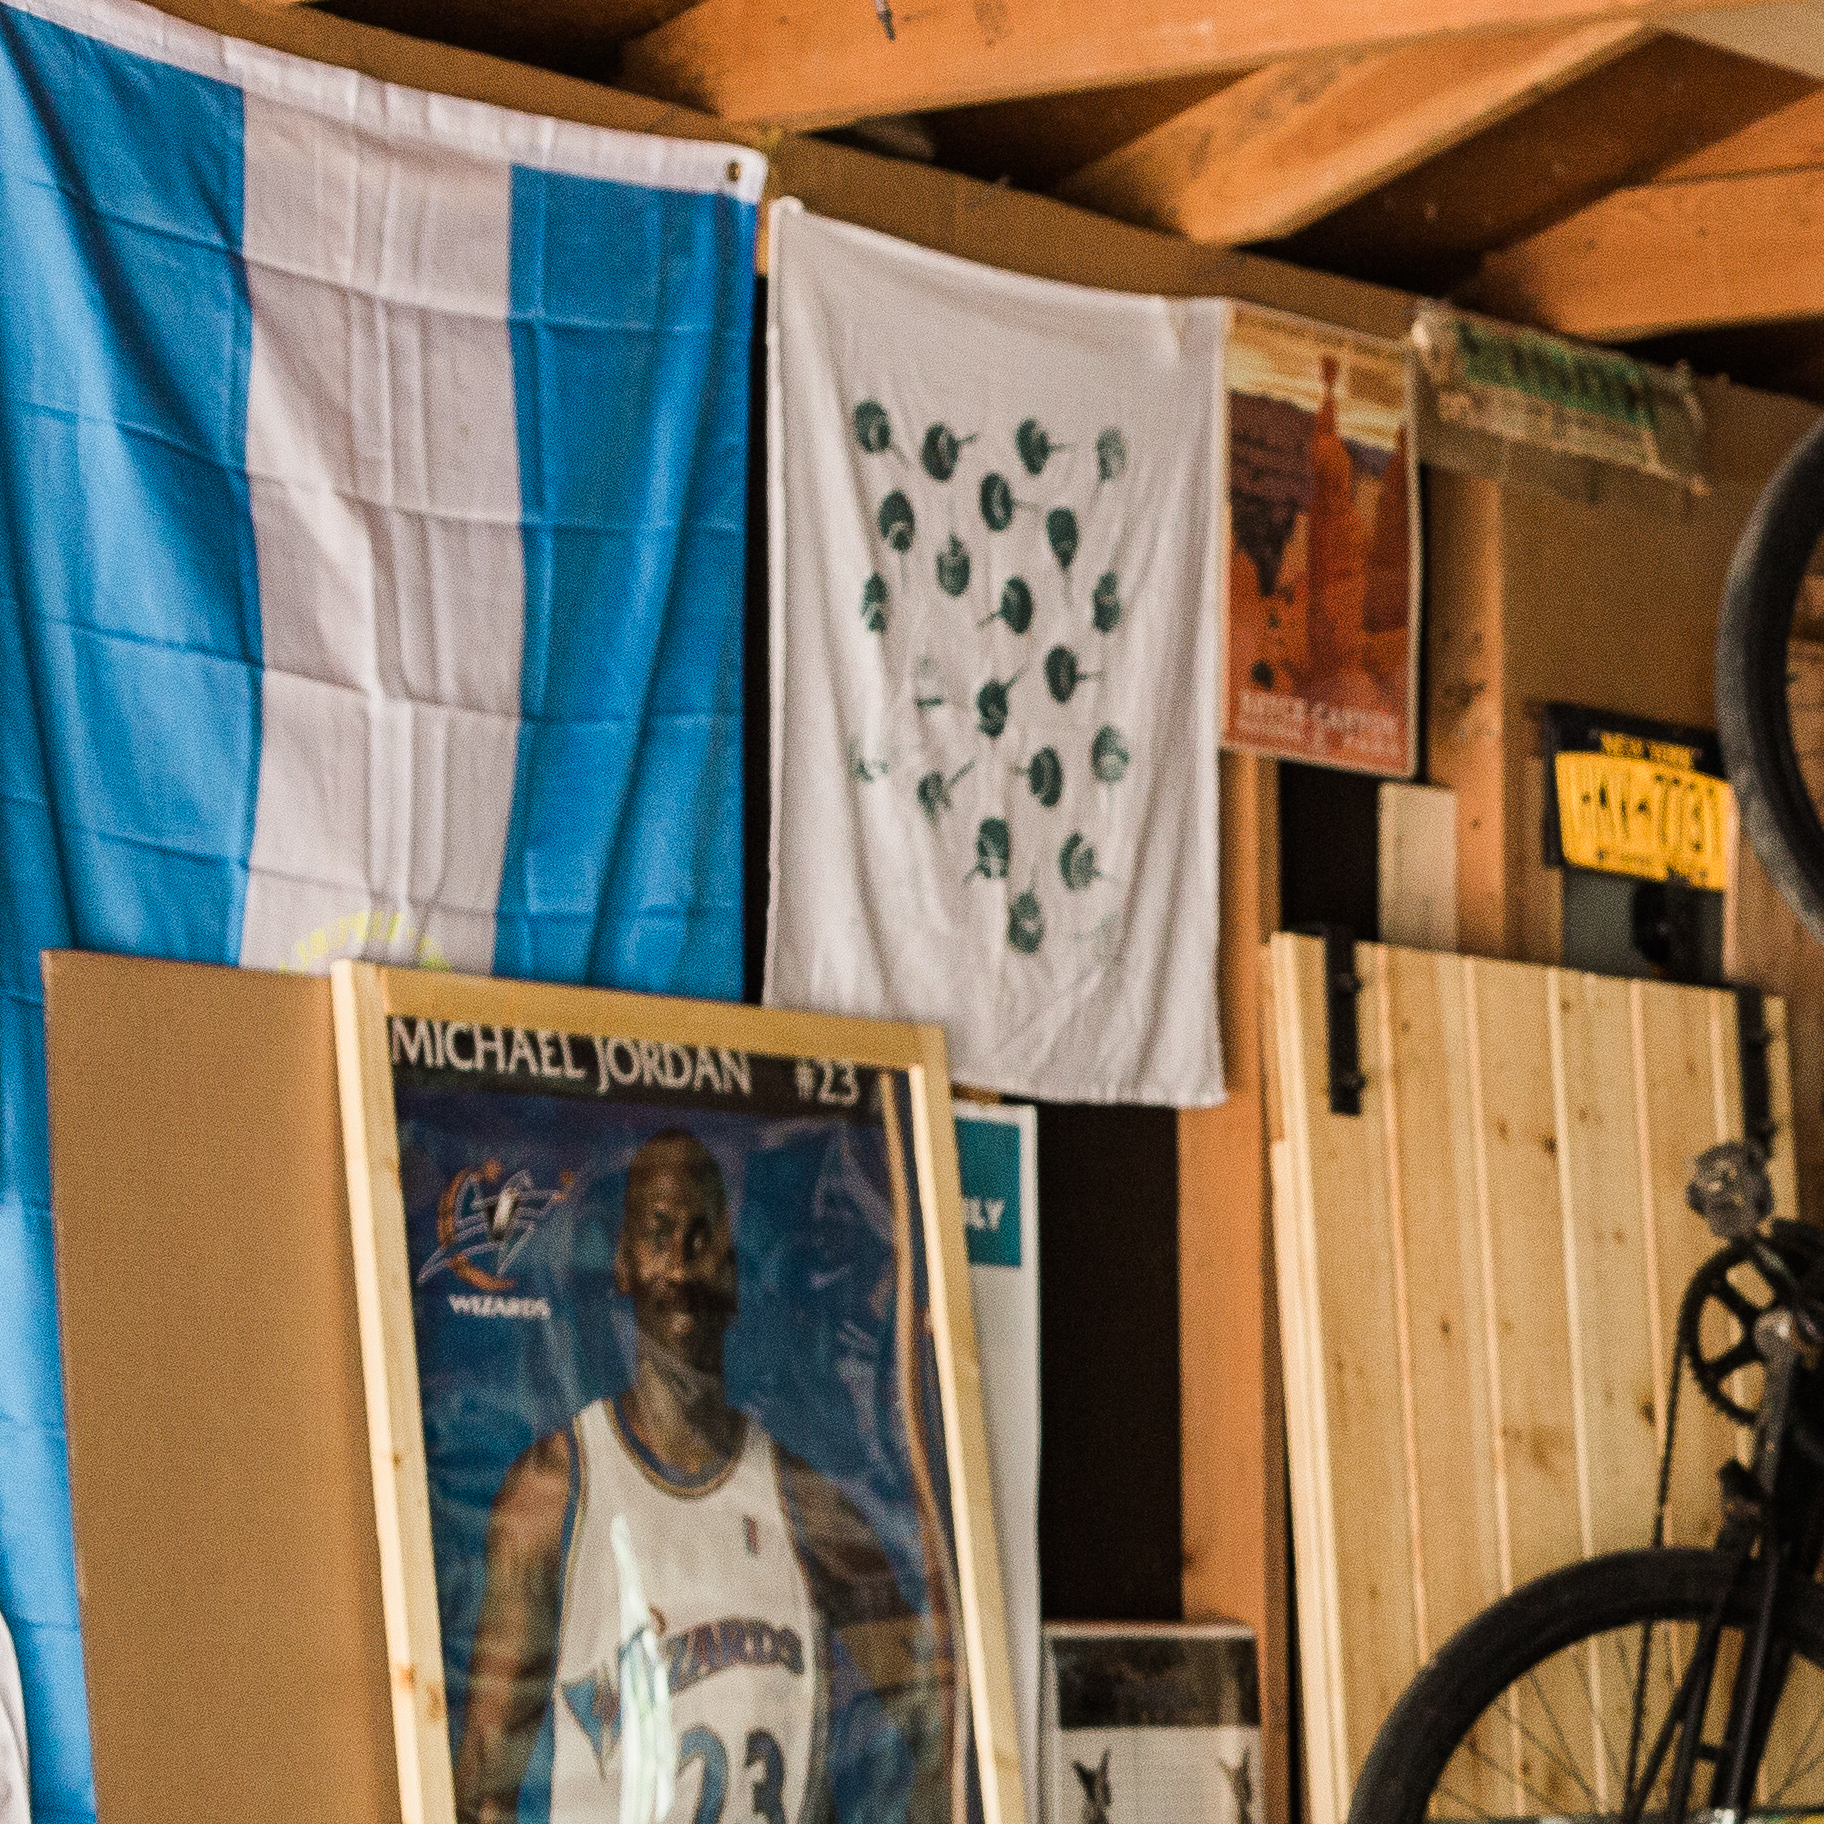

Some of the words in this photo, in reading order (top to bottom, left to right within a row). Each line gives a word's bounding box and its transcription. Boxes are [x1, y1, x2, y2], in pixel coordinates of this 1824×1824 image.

[391, 1017, 587, 1081] MICHAEL
[595, 1035, 754, 1096] JORDAN
[796, 1057, 860, 1104] #23
[447, 1294, 552, 1320] WIZARDS
